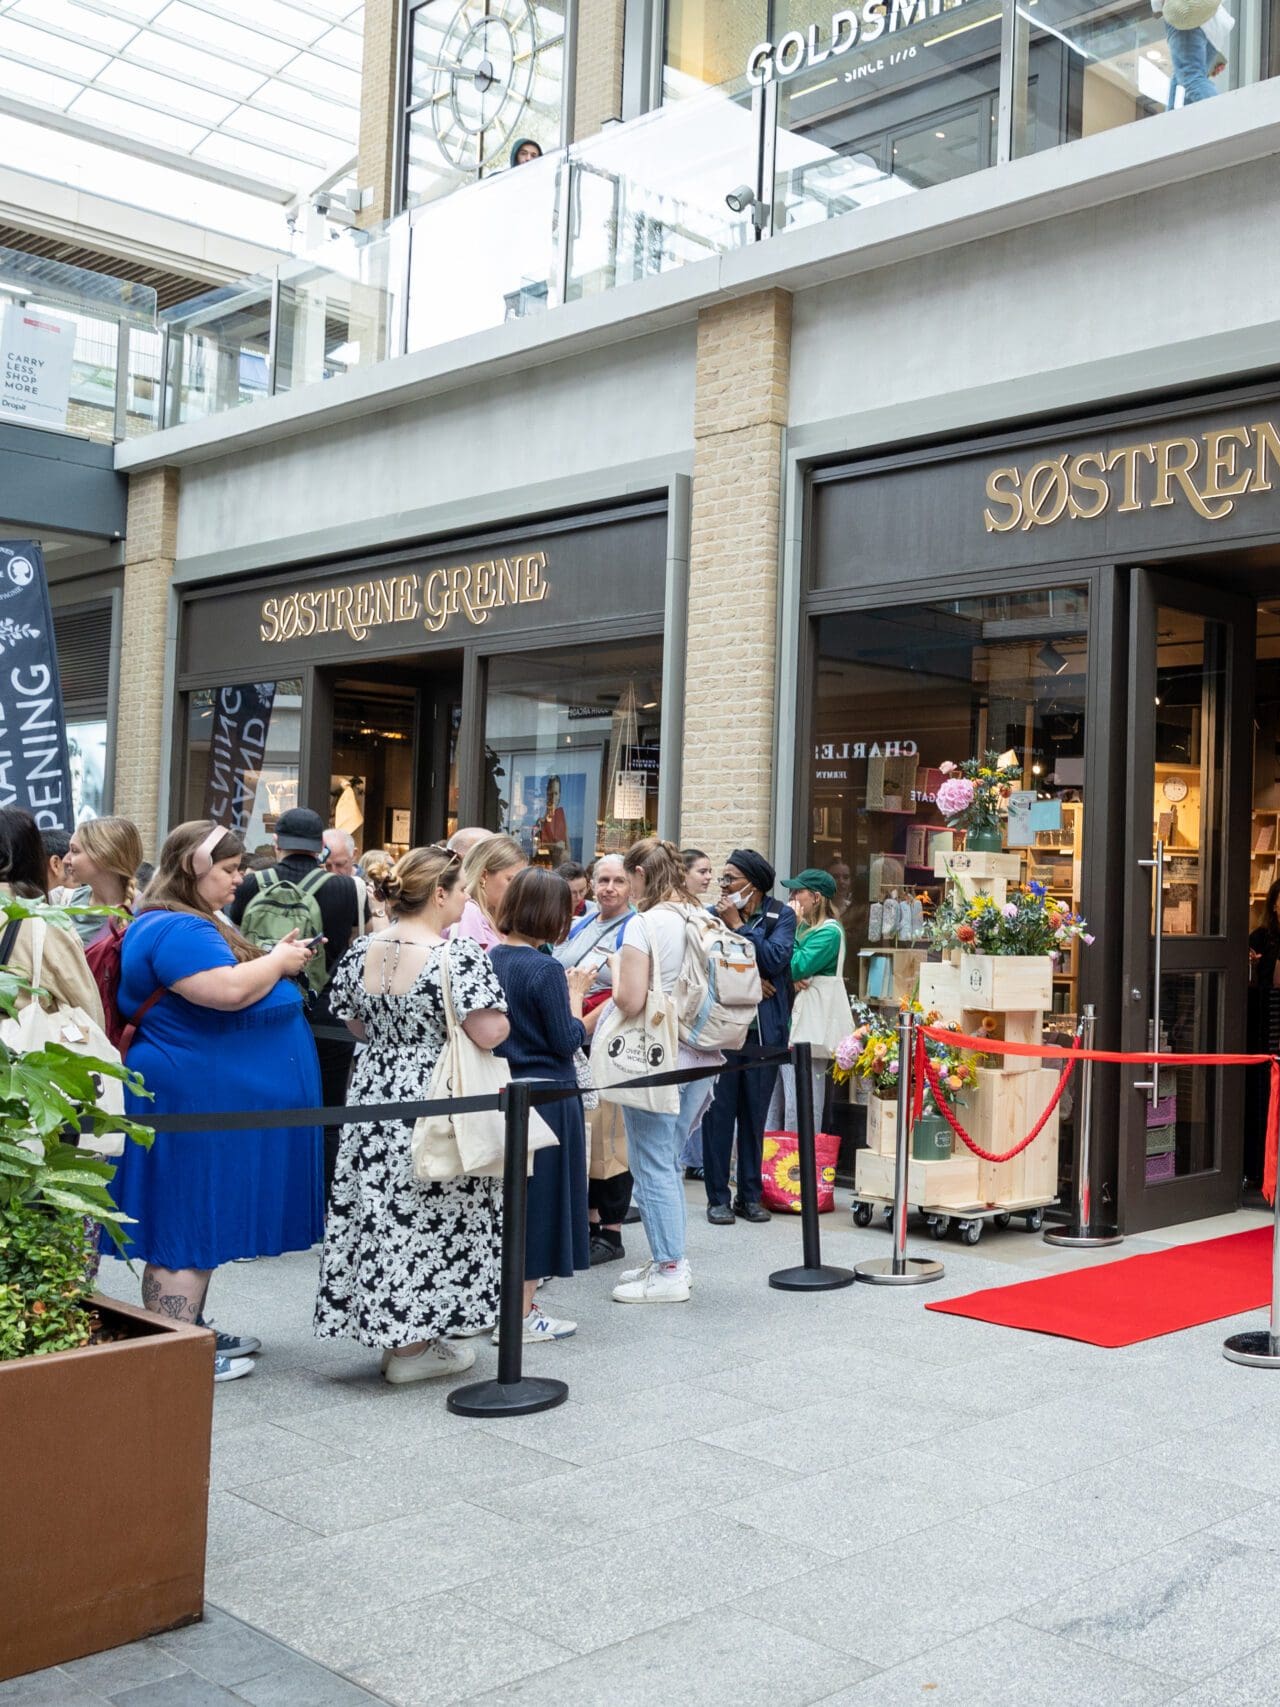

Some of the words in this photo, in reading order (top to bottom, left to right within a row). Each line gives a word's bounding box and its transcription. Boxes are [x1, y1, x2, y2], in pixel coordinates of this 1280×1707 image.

[746, 0, 967, 86] GOLDSM
[844, 59, 885, 83] SINCE
[7, 352, 45, 368] CARRY
[4, 381, 39, 395] MORE
[5, 371, 37, 385] SHOP
[260, 573, 420, 643] SØSTRENE
[423, 551, 549, 632] GRENE
[10, 663, 65, 831] PENING
